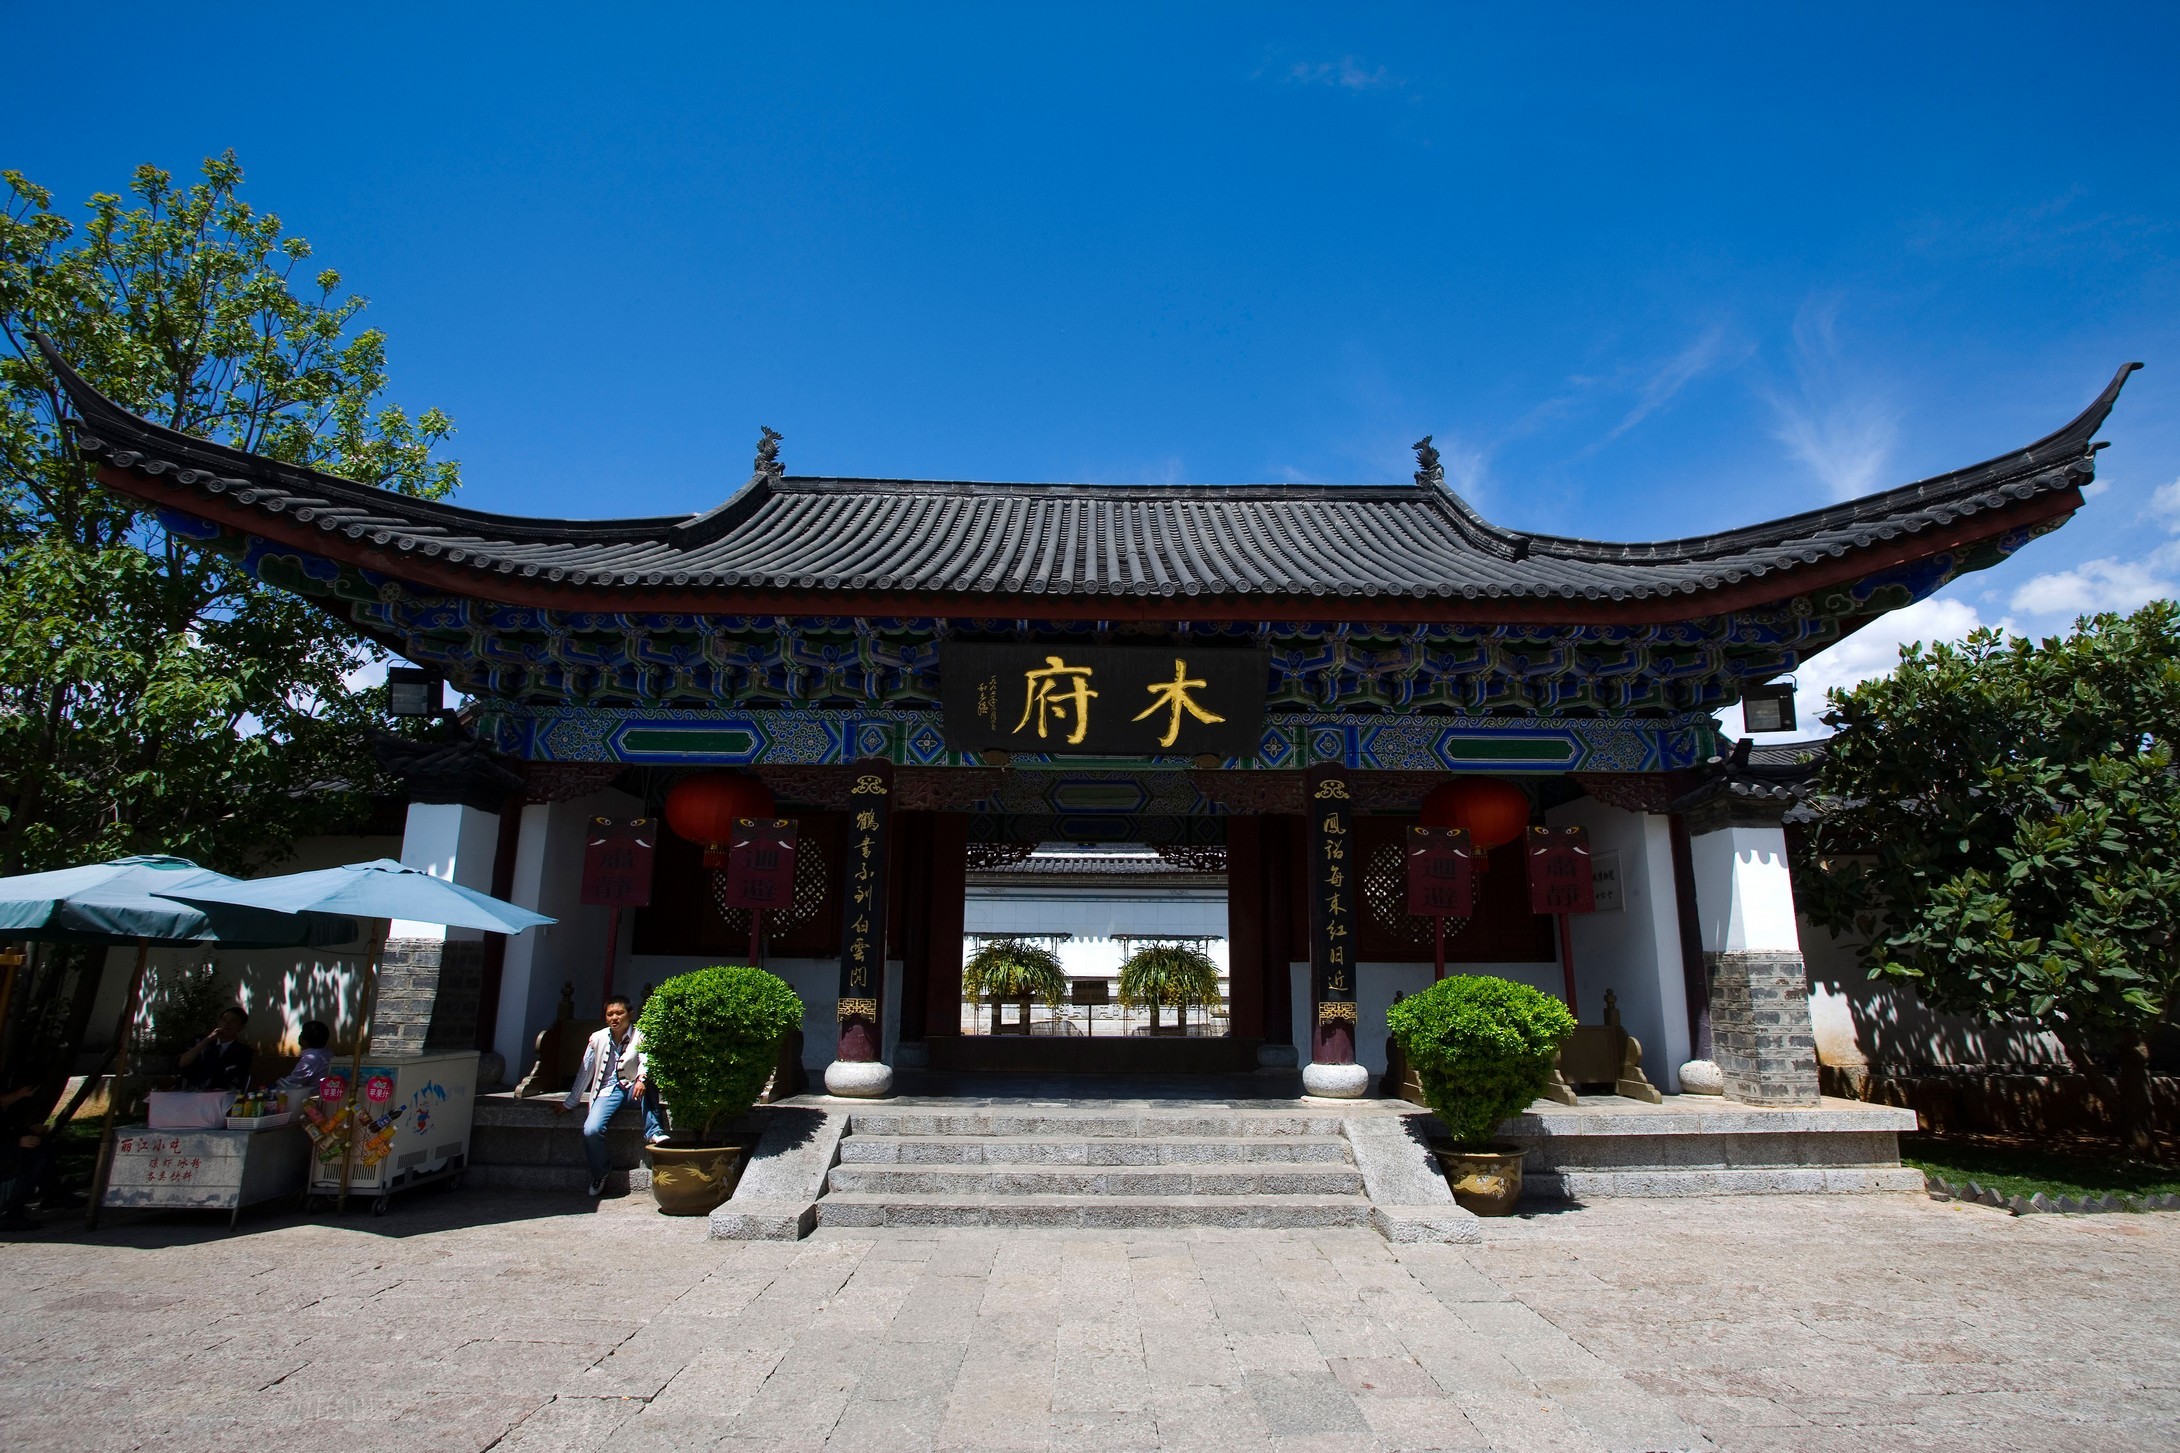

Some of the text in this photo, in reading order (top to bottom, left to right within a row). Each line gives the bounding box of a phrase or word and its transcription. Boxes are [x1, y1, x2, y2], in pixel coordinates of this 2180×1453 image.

[369, 1088, 390, 1098] 苹果汁
[121, 1137, 182, 1154] 丽江小吃
[147, 1170, 192, 1182] 各类饮料
